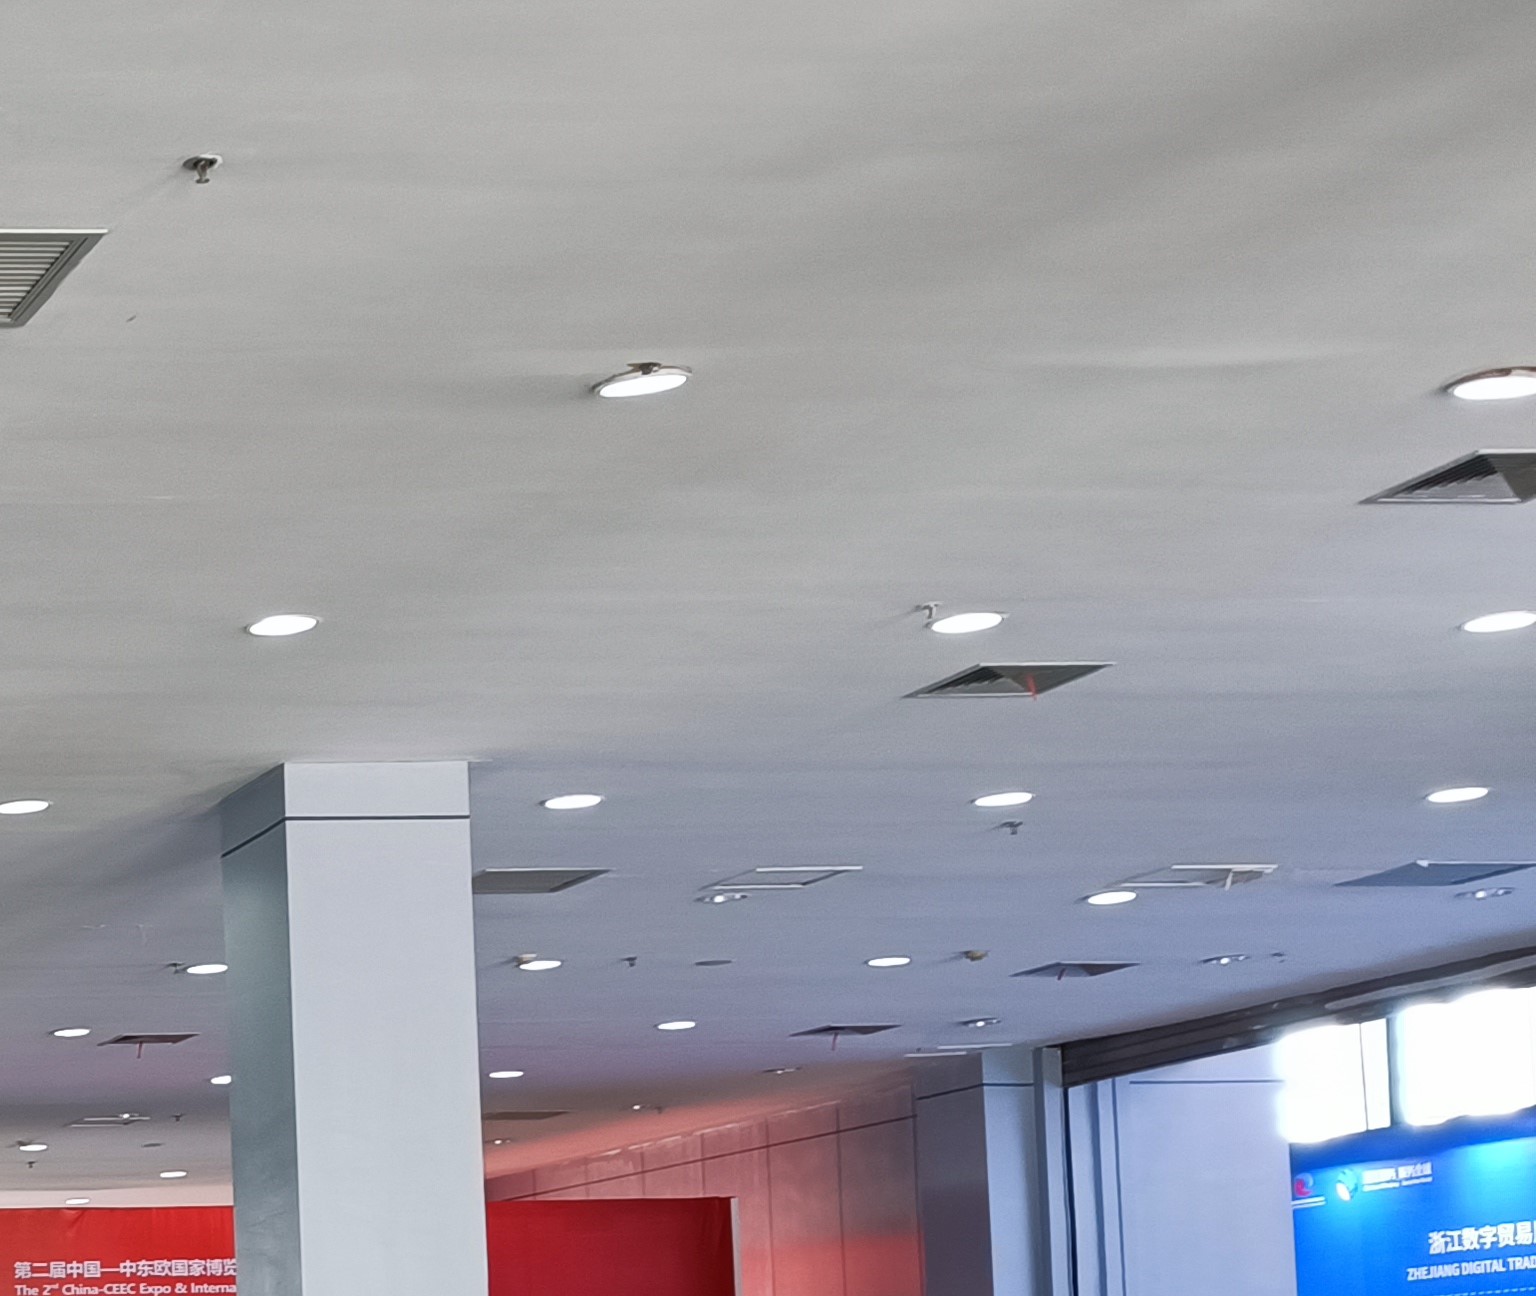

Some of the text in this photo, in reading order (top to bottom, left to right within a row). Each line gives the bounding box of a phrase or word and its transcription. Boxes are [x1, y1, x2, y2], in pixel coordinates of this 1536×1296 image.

[1428, 1220, 1536, 1255] 浙江数字贸易
[1407, 1263, 1459, 1281] ZHEJIANG
[1461, 1259, 1506, 1275] DIGITAL
[14, 1284, 38, 1296] The
[42, 1283, 59, 1296] 2nd
[62, 1283, 135, 1296] China-CEEC
[139, 1283, 171, 1296] Expo
[174, 1283, 188, 1294] &
